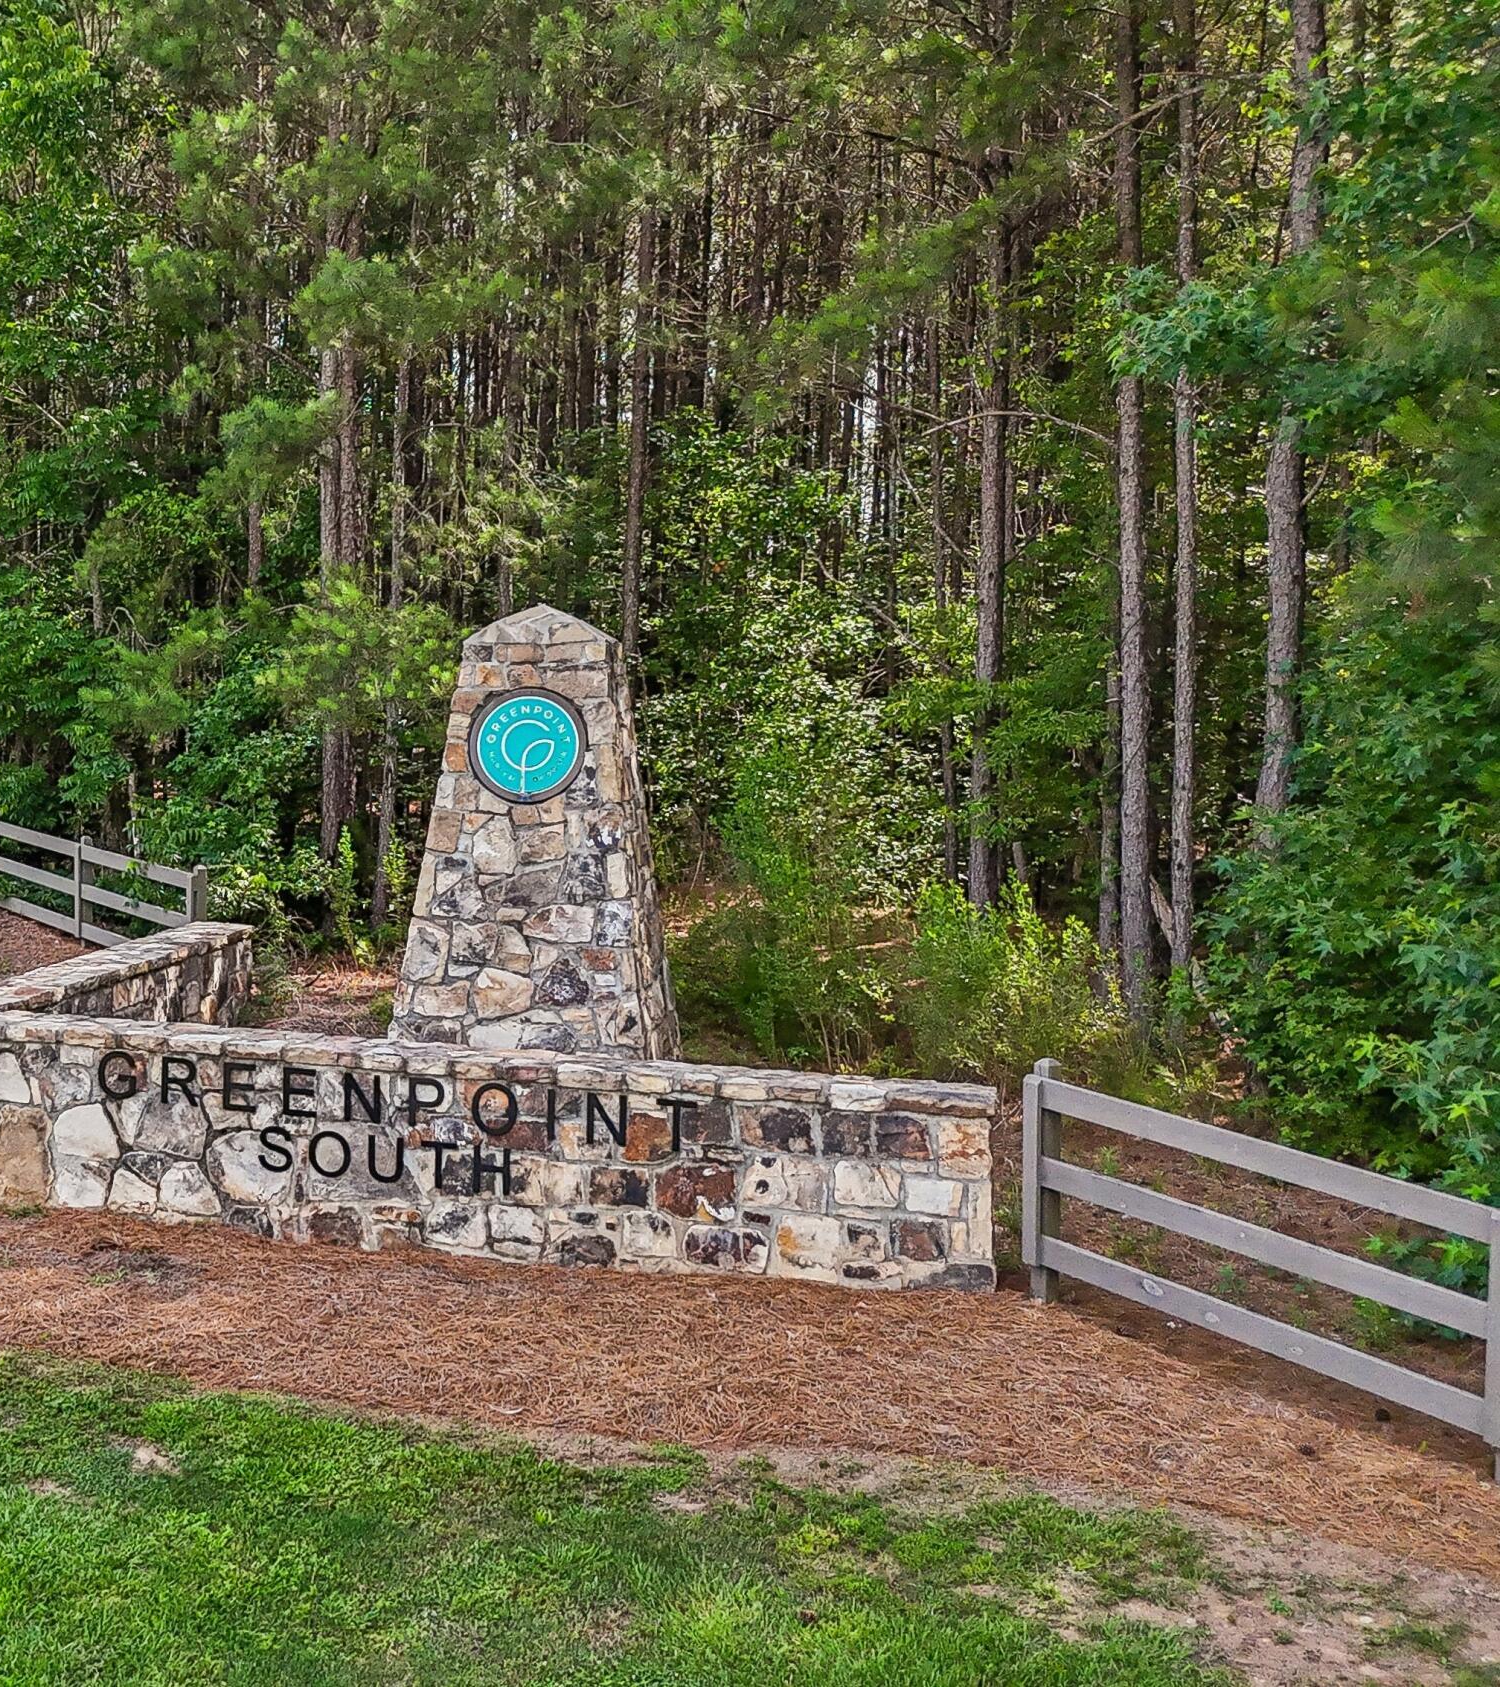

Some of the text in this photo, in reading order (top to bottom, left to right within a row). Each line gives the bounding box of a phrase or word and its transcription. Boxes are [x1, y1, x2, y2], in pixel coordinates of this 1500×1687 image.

[486, 705, 571, 744] GREENPOINT
[98, 1050, 698, 1153] GREENPOINT
[257, 1125, 513, 1196] SOUTH
